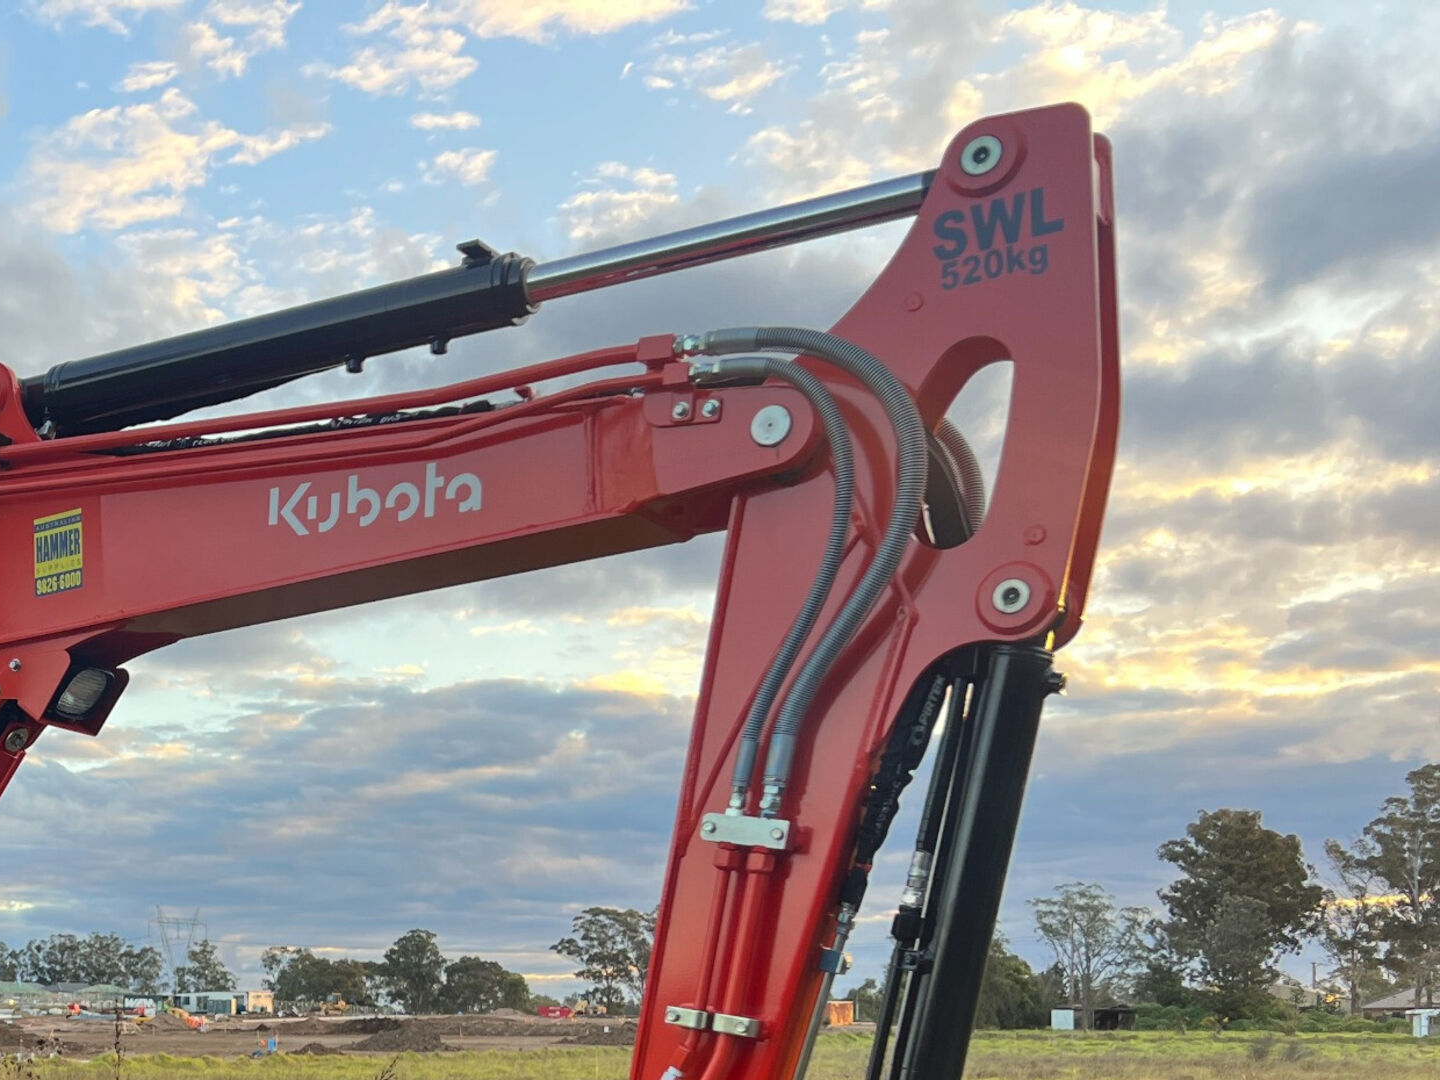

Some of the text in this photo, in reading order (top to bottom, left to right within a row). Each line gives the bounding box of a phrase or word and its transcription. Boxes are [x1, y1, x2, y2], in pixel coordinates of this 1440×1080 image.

[933, 186, 1065, 260] SWL
[941, 243, 1049, 291] 520kg
[268, 462, 482, 536] Kubota
[36, 528, 81, 563] HAMMER
